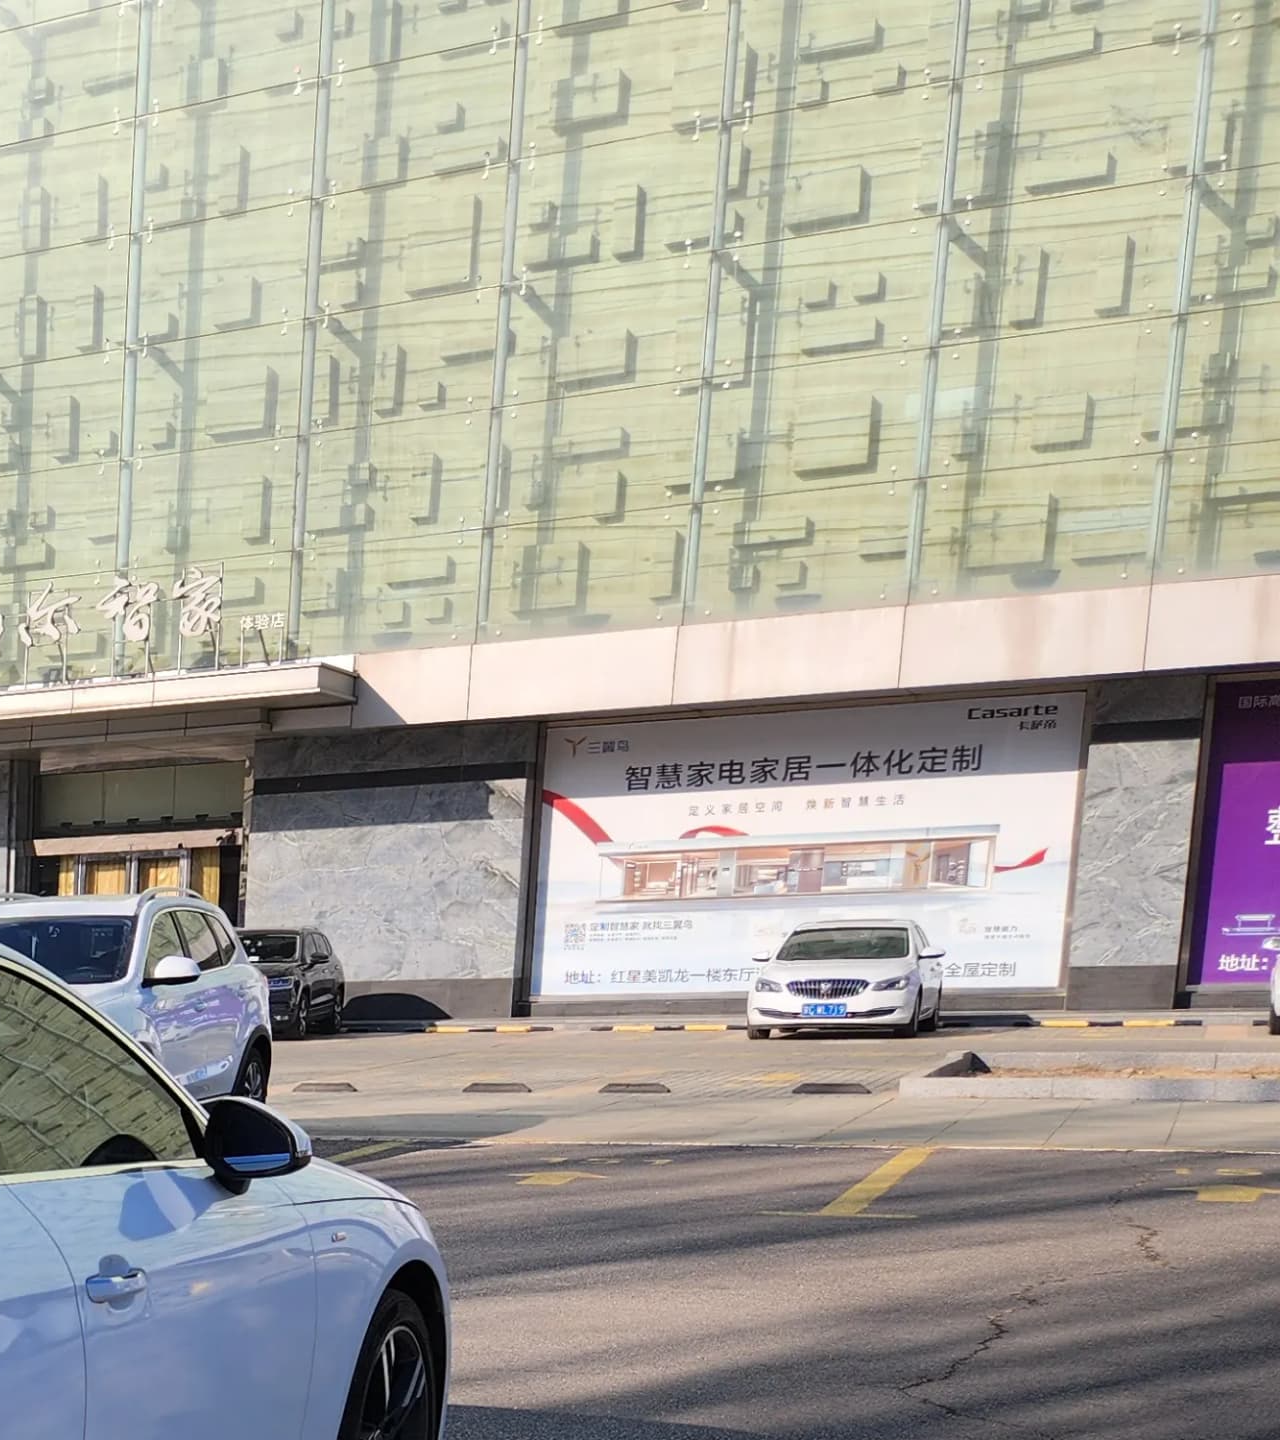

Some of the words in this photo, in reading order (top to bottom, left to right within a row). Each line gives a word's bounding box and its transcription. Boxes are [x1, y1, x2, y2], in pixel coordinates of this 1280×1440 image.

[240, 612, 286, 630] 体验店
[967, 704, 1059, 720] Casarte
[587, 740, 630, 755] 三翼鸟
[625, 744, 984, 792] 智慧家电家居一体化定制
[688, 800, 784, 817] 定义家居空间
[564, 967, 762, 984] 地址：红星美凯龙一楼东厅
[944, 962, 1016, 977] 全屋定制
